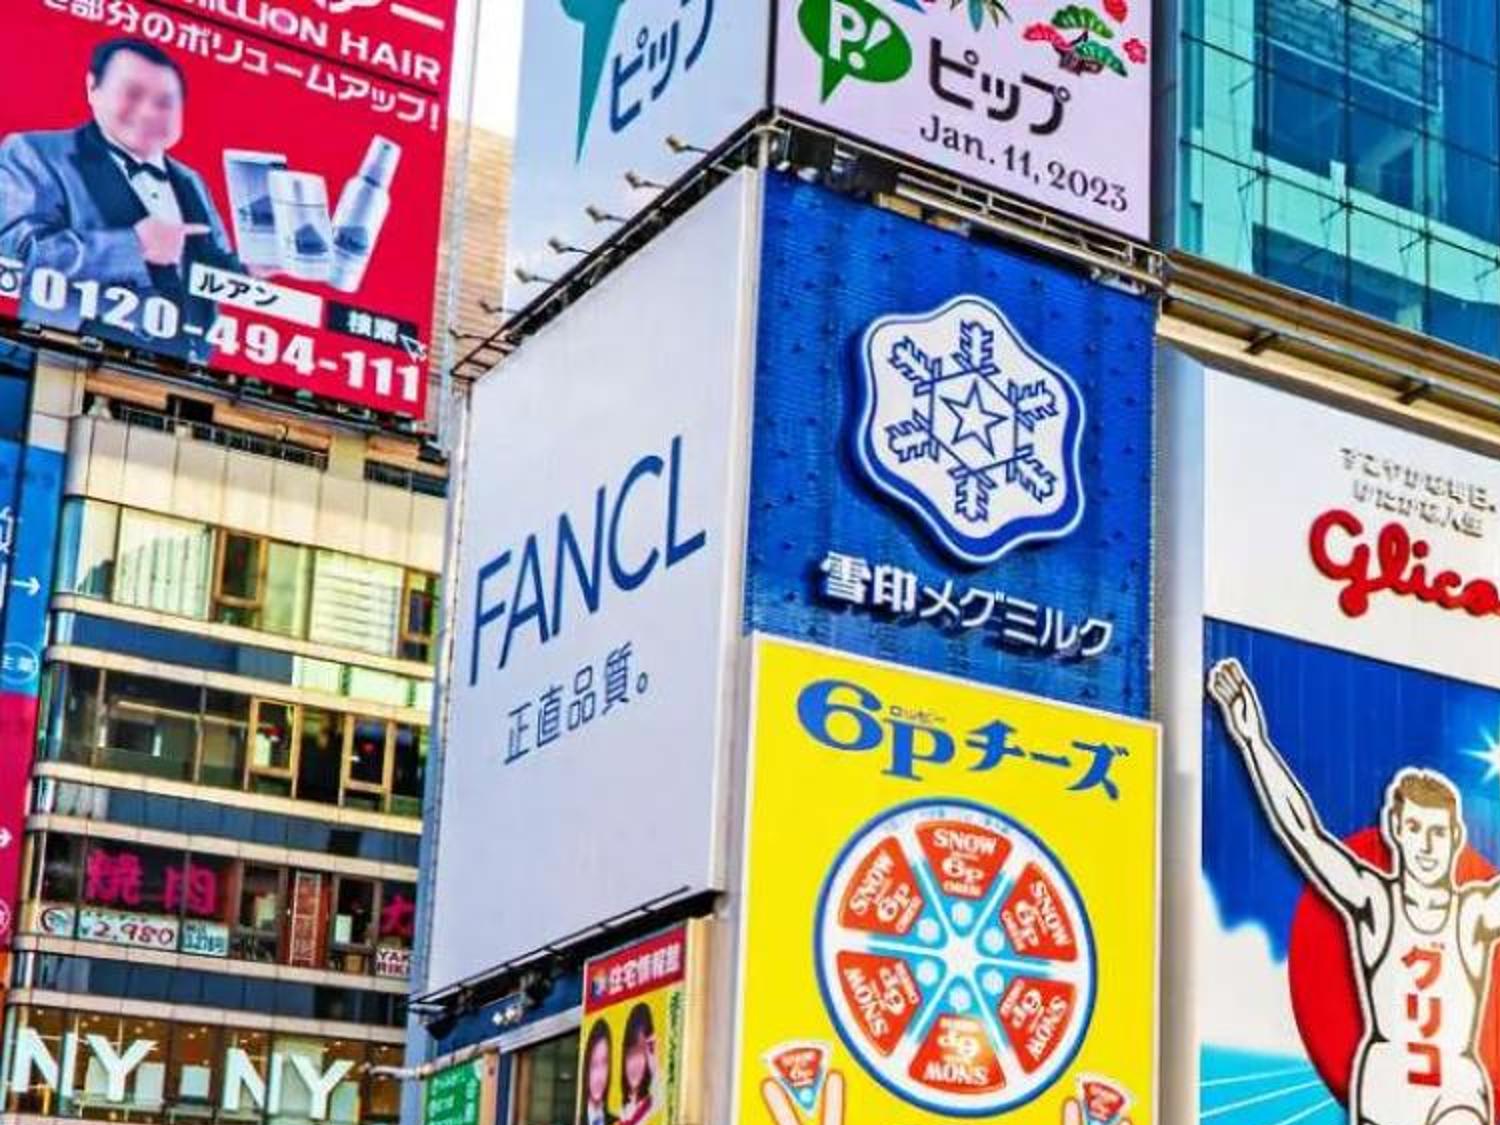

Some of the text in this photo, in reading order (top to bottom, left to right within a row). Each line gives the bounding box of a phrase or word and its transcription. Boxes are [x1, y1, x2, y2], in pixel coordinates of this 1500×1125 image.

[338, 29, 442, 85] HAIR
[928, 36, 1071, 136] ピップ
[920, 115, 1128, 212] Jan. 11, 2023
[30, 266, 421, 402] 0120-494-111
[198, 270, 280, 307] ルアン
[468, 434, 706, 687] FANCL
[819, 550, 1114, 657] 雪印メグミルク
[503, 641, 650, 766] 正直品質。
[931, 827, 1000, 858] SNOW
[1401, 940, 1446, 1088] グリコ
